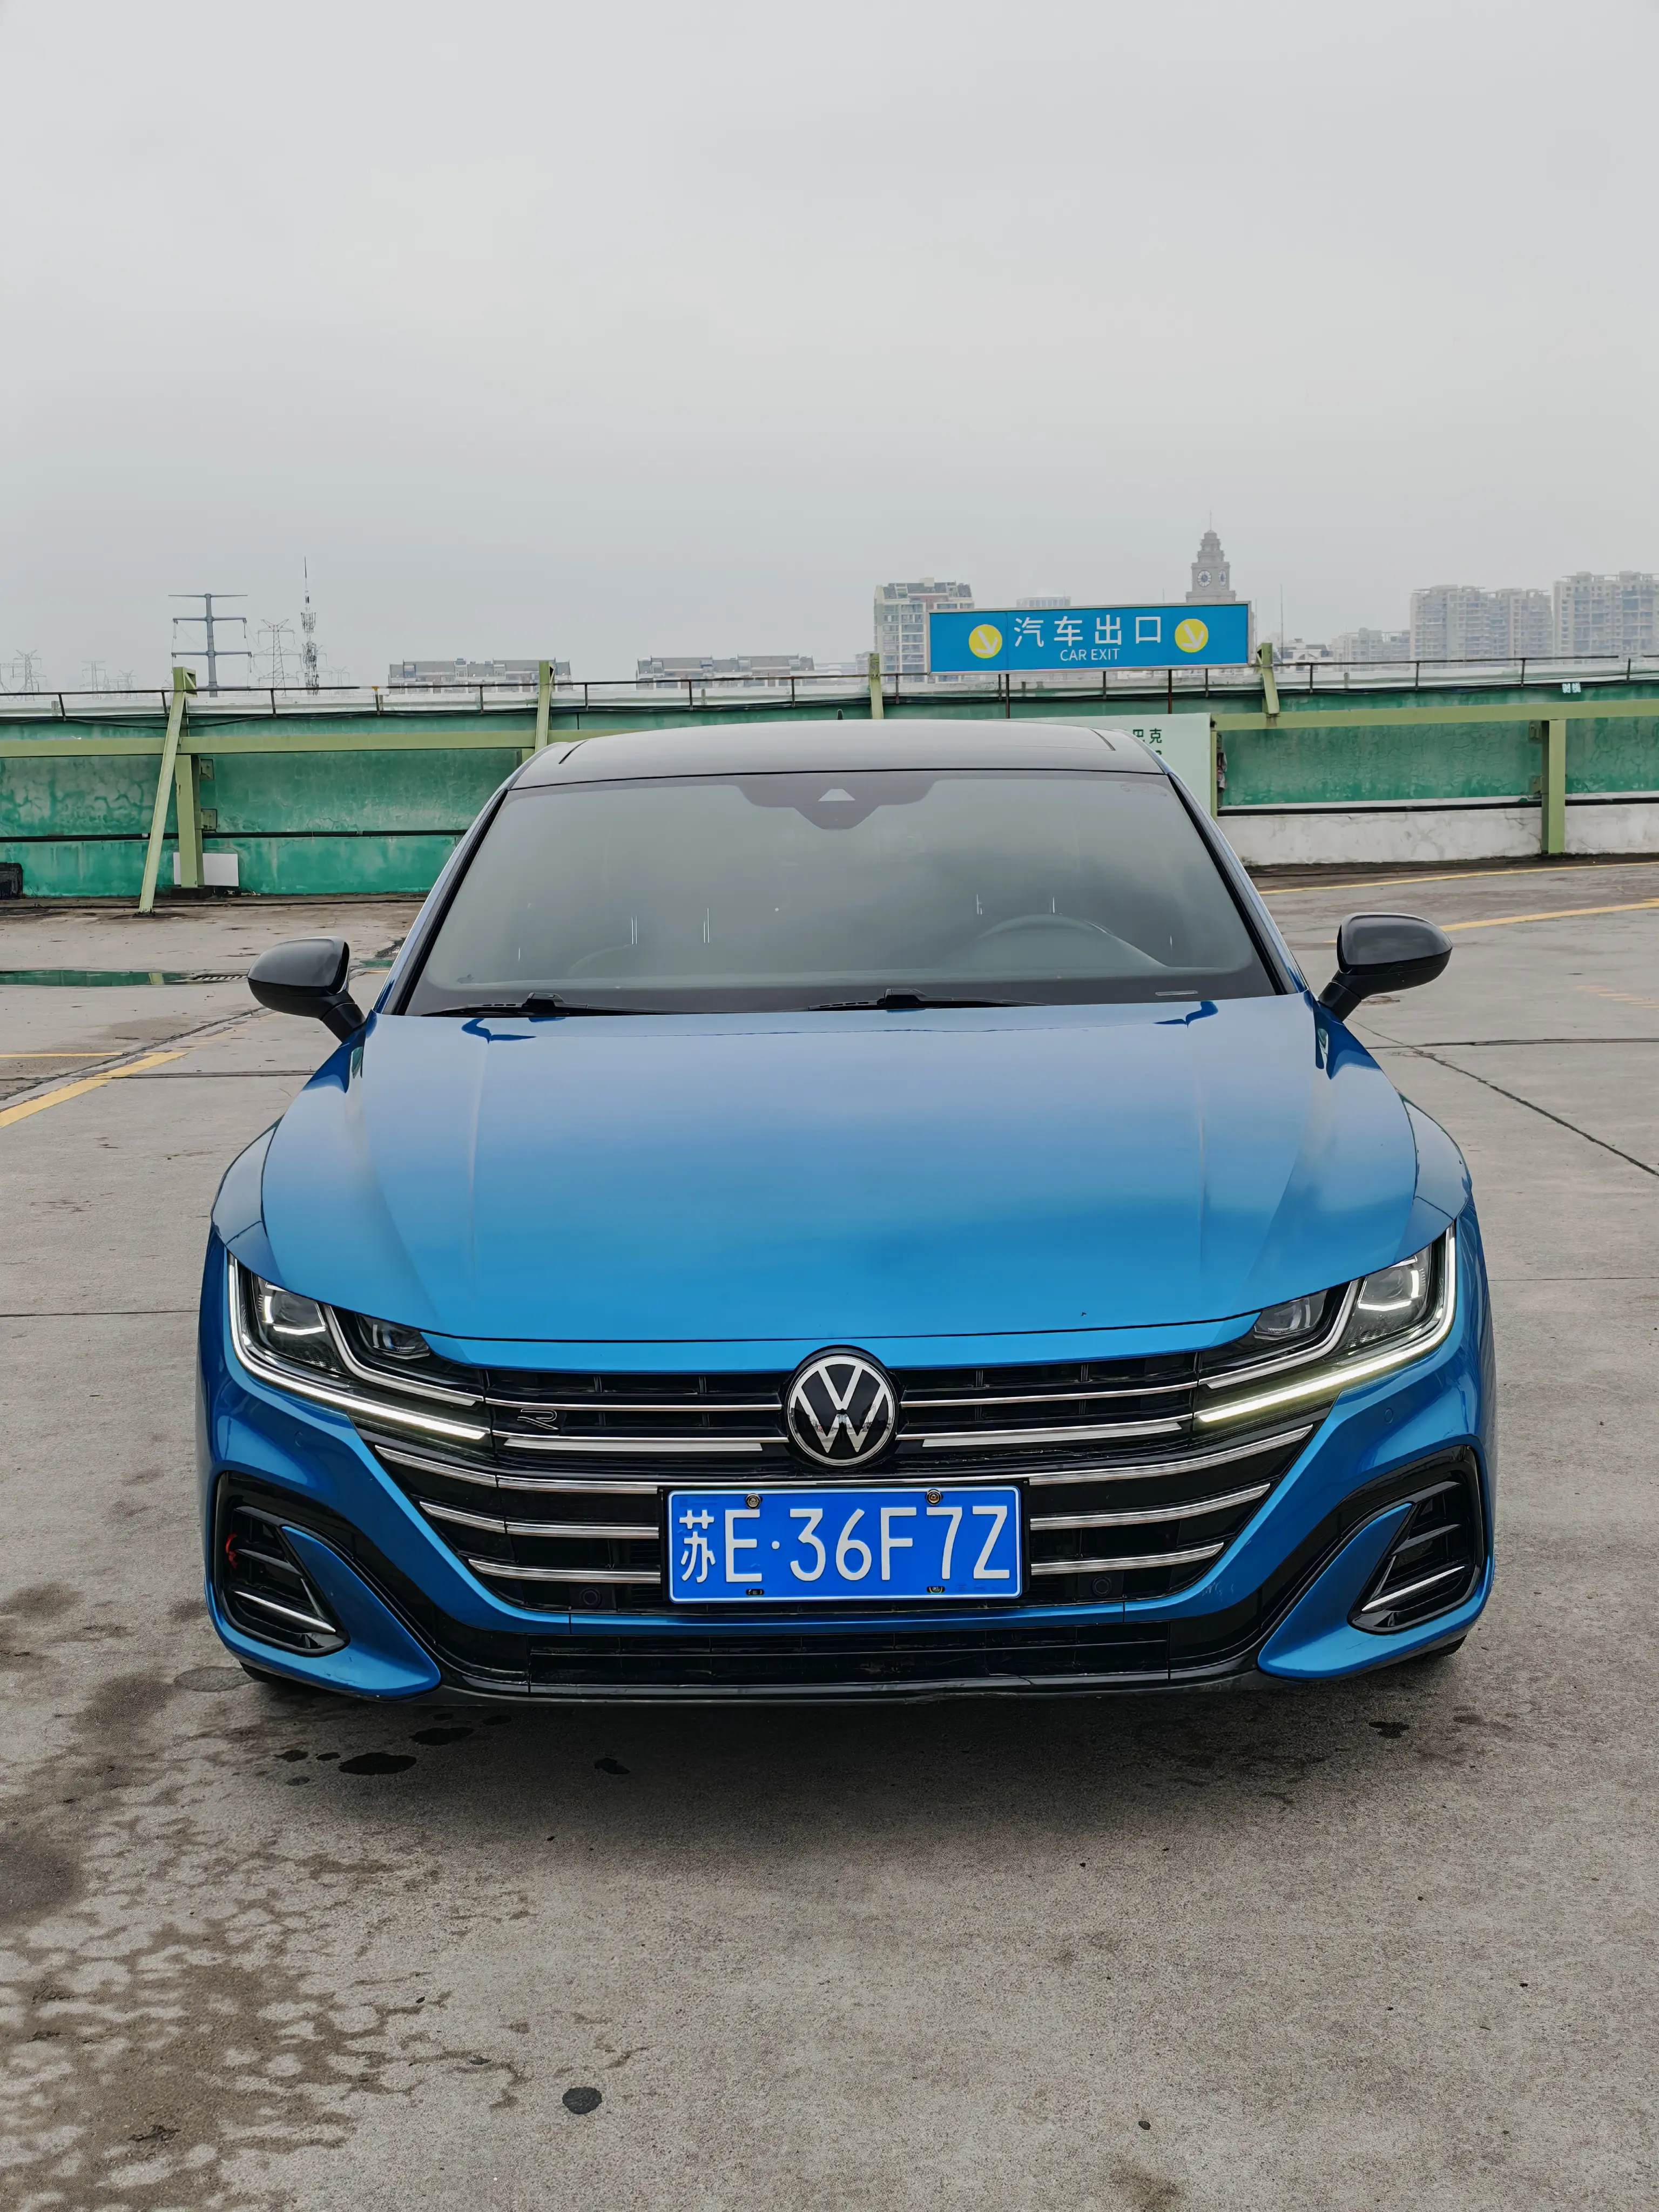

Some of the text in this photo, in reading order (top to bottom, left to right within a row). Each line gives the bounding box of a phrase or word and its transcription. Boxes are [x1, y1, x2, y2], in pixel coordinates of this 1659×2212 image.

[1014, 615, 1161, 647] 汽车出口
[1060, 649, 1120, 661] CAR EXIT
